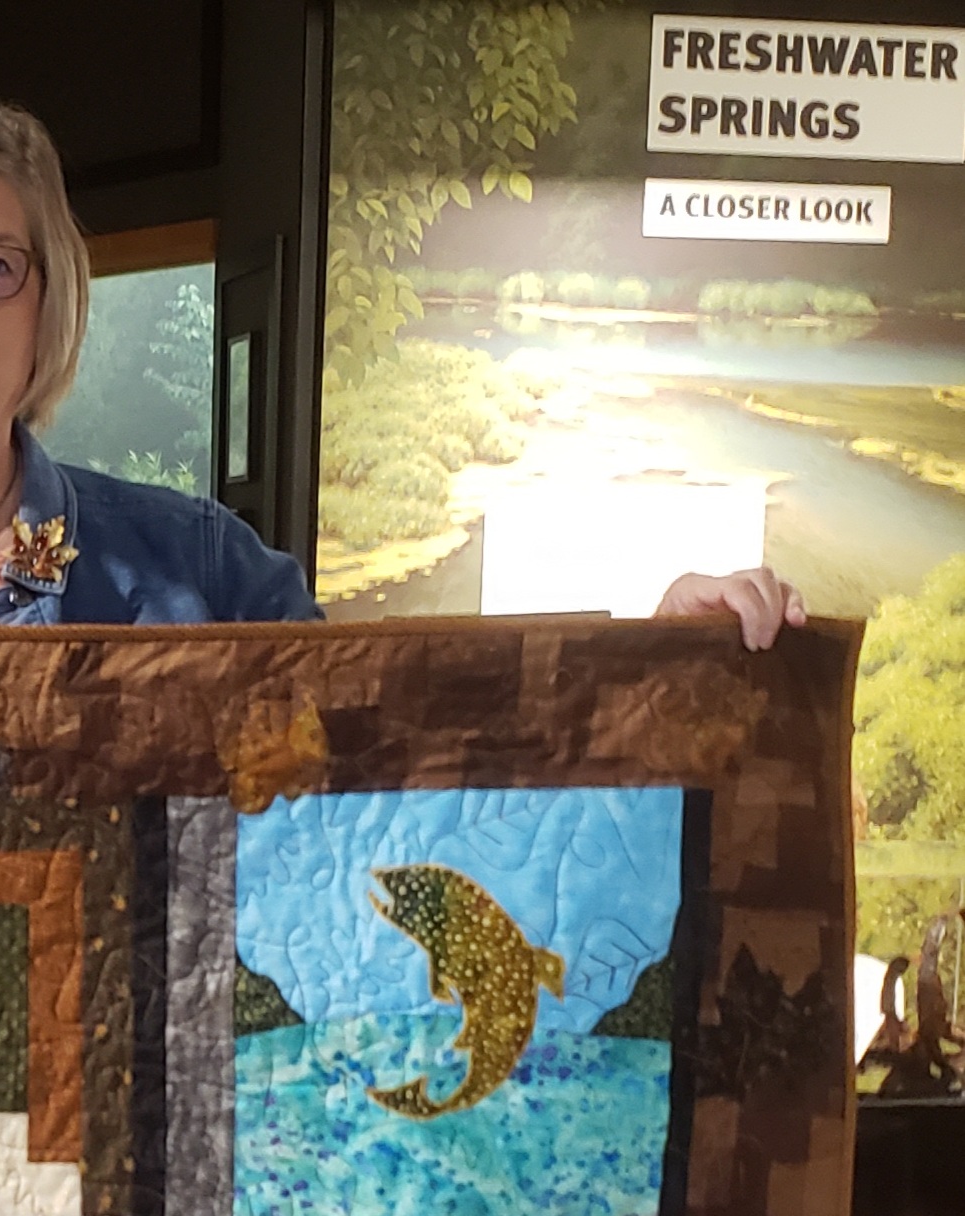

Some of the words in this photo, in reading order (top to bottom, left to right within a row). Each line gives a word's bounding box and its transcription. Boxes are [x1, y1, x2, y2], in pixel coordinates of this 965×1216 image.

[662, 28, 959, 81] FRESHWATER
[657, 94, 860, 141] SPRINGS
[659, 193, 676, 217] A
[685, 193, 790, 221] CLOSER
[799, 197, 874, 225] LOOK
